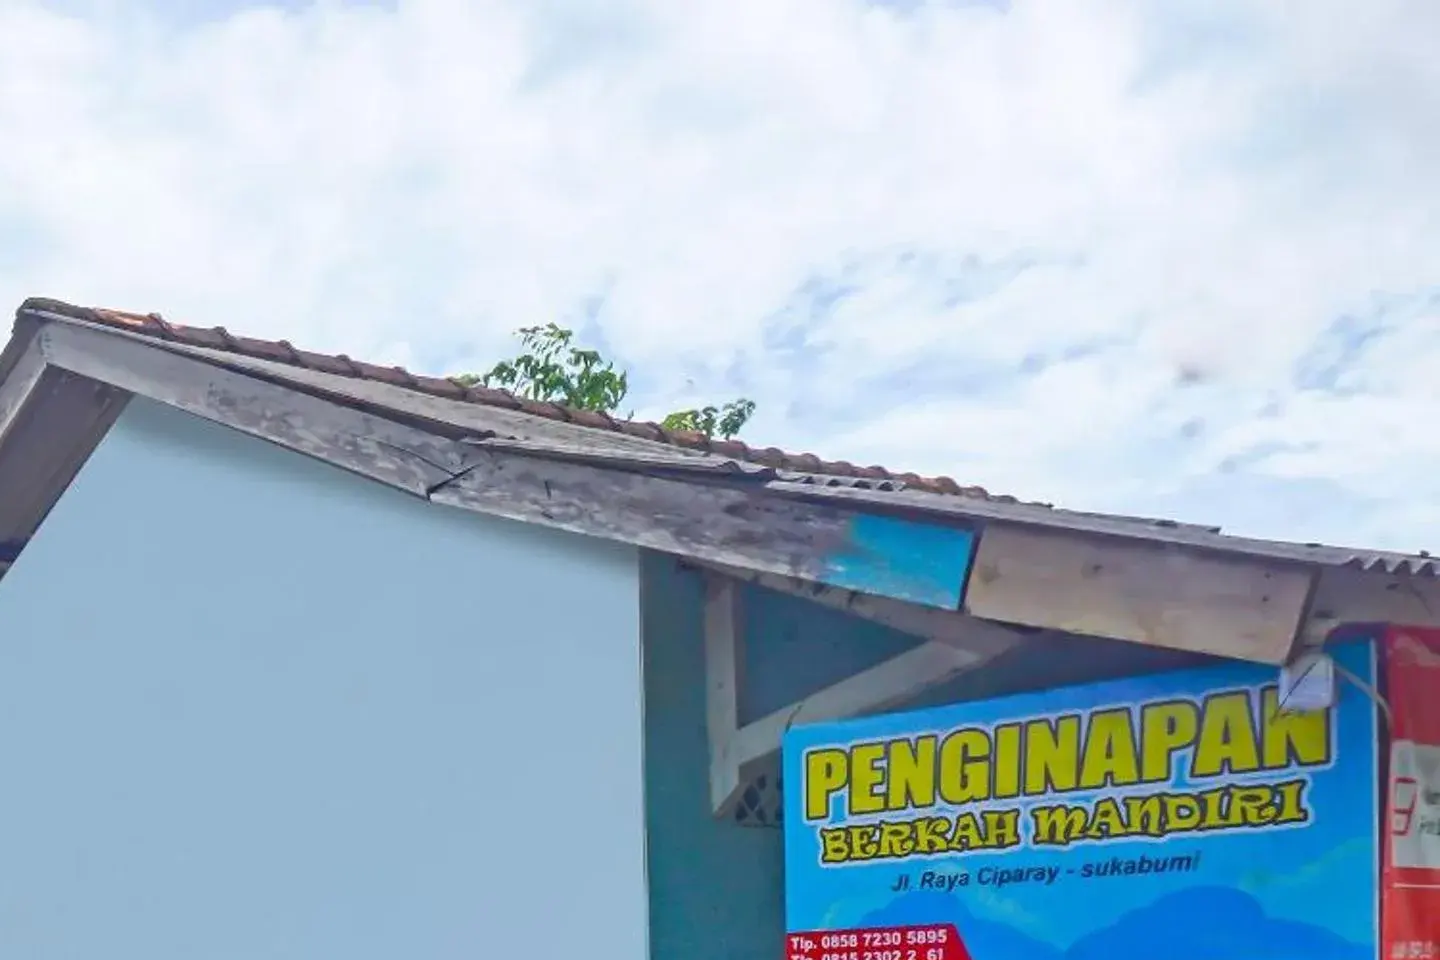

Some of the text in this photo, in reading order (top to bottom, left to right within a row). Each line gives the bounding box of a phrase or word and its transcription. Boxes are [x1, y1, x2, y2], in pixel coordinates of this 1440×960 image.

[806, 685, 1332, 820] PENGINAPAN
[920, 871, 970, 893] Raya
[976, 865, 1061, 889] Ciparay
[1080, 851, 1202, 879] sukabumi
[821, 935, 858, 949] 0858
[862, 931, 902, 947] 7230
[906, 929, 948, 945] 5895
